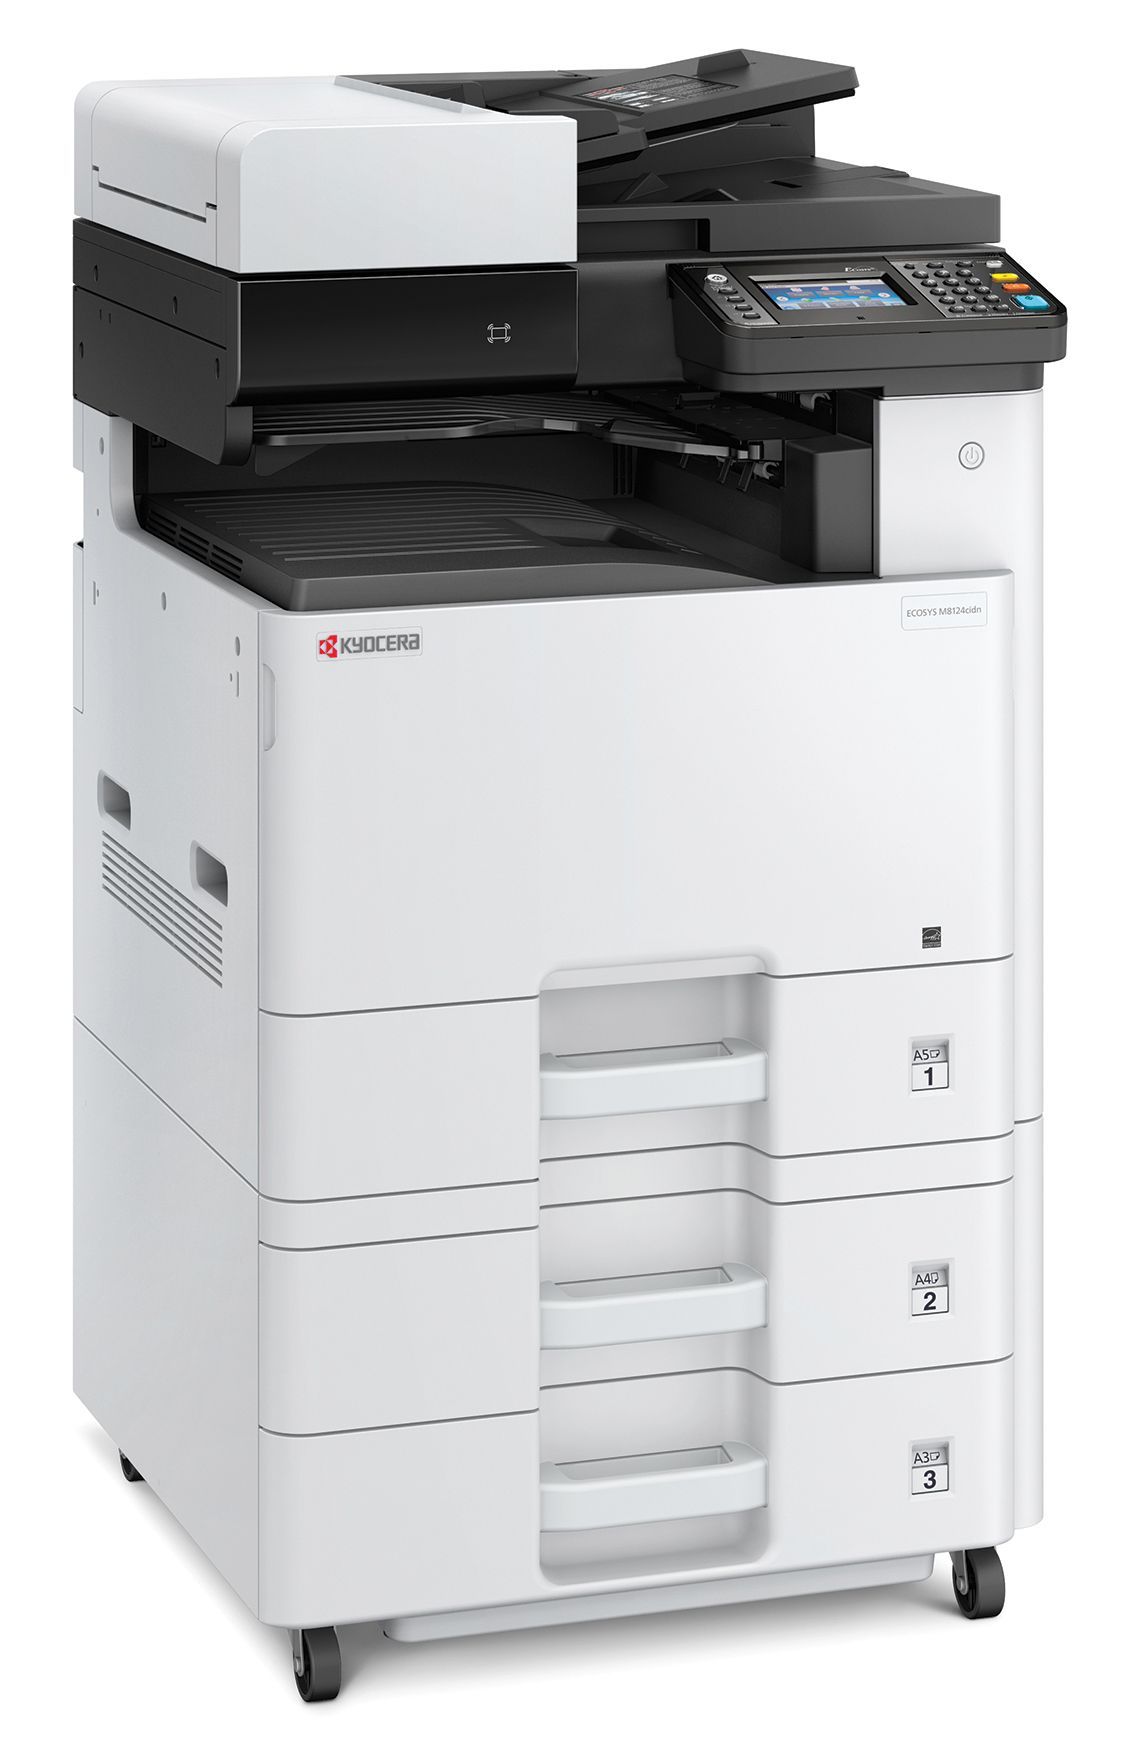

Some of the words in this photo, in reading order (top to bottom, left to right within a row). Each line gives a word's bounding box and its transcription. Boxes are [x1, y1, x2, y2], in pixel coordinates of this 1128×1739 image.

[906, 608, 937, 617] ECOSYS
[939, 605, 982, 615] M8124cidn
[340, 634, 420, 654] KYOCERA
[913, 1049, 930, 1061] A5
[924, 1067, 933, 1086] 1
[915, 1272, 931, 1286] A4
[923, 1291, 937, 1311] 2
[913, 1451, 930, 1464] A3
[923, 1469, 937, 1489] 3
